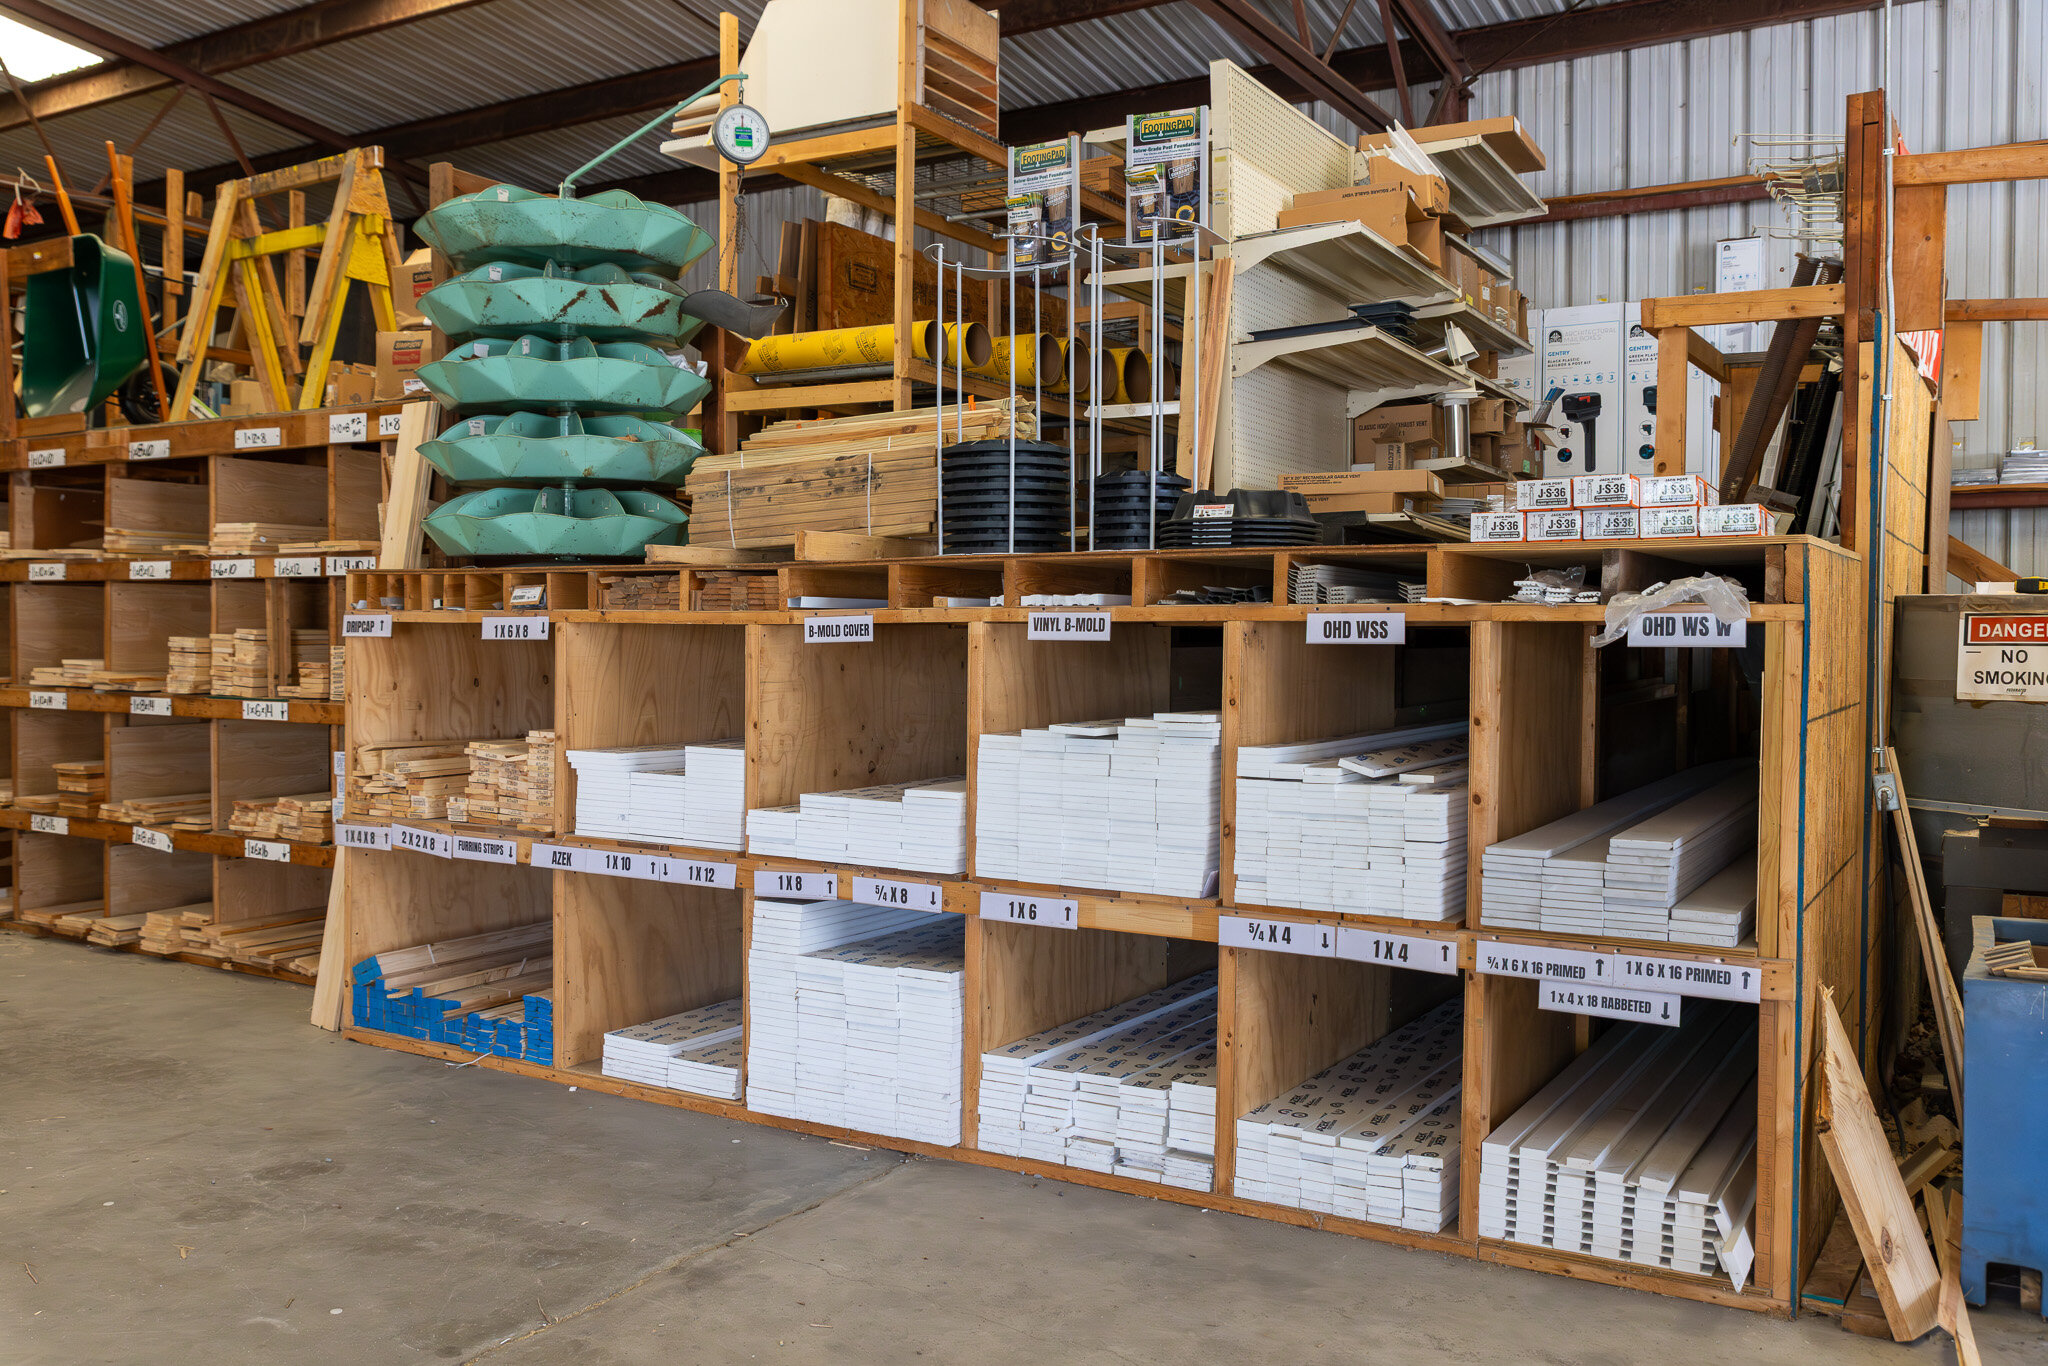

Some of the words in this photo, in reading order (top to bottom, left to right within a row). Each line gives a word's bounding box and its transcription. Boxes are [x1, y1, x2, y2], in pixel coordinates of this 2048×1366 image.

[394, 340, 423, 349] SIMPSON
[346, 620, 374, 633] DRIPCAP
[809, 625, 841, 638] B-MOLD
[843, 624, 869, 637] COVER
[1033, 617, 1061, 632] VINYL
[1065, 618, 1106, 632] B-MOLD
[1323, 620, 1351, 638] OHD
[1356, 620, 1388, 639] WSS
[1643, 616, 1676, 636] OHD
[1682, 616, 1710, 636] WS
[1716, 618, 1732, 636] W
[1979, 623, 2048, 638] DANGE
[2001, 650, 2028, 663] NO
[1974, 671, 2048, 686] SMOKIN
[458, 840, 482, 853] FURRING
[484, 842, 504, 855] STRIPS
[552, 851, 572, 866] AZEK
[1512, 959, 1519, 972] 6
[1531, 961, 1543, 975] 16
[1546, 962, 1586, 980] PRIMED
[1646, 962, 1654, 977] 6
[1669, 965, 1682, 980] 16
[1685, 966, 1731, 985] PRIMED
[1567, 992, 1574, 1005] 4
[1586, 995, 1598, 1008] 18
[1601, 996, 1651, 1014] RABBETED
